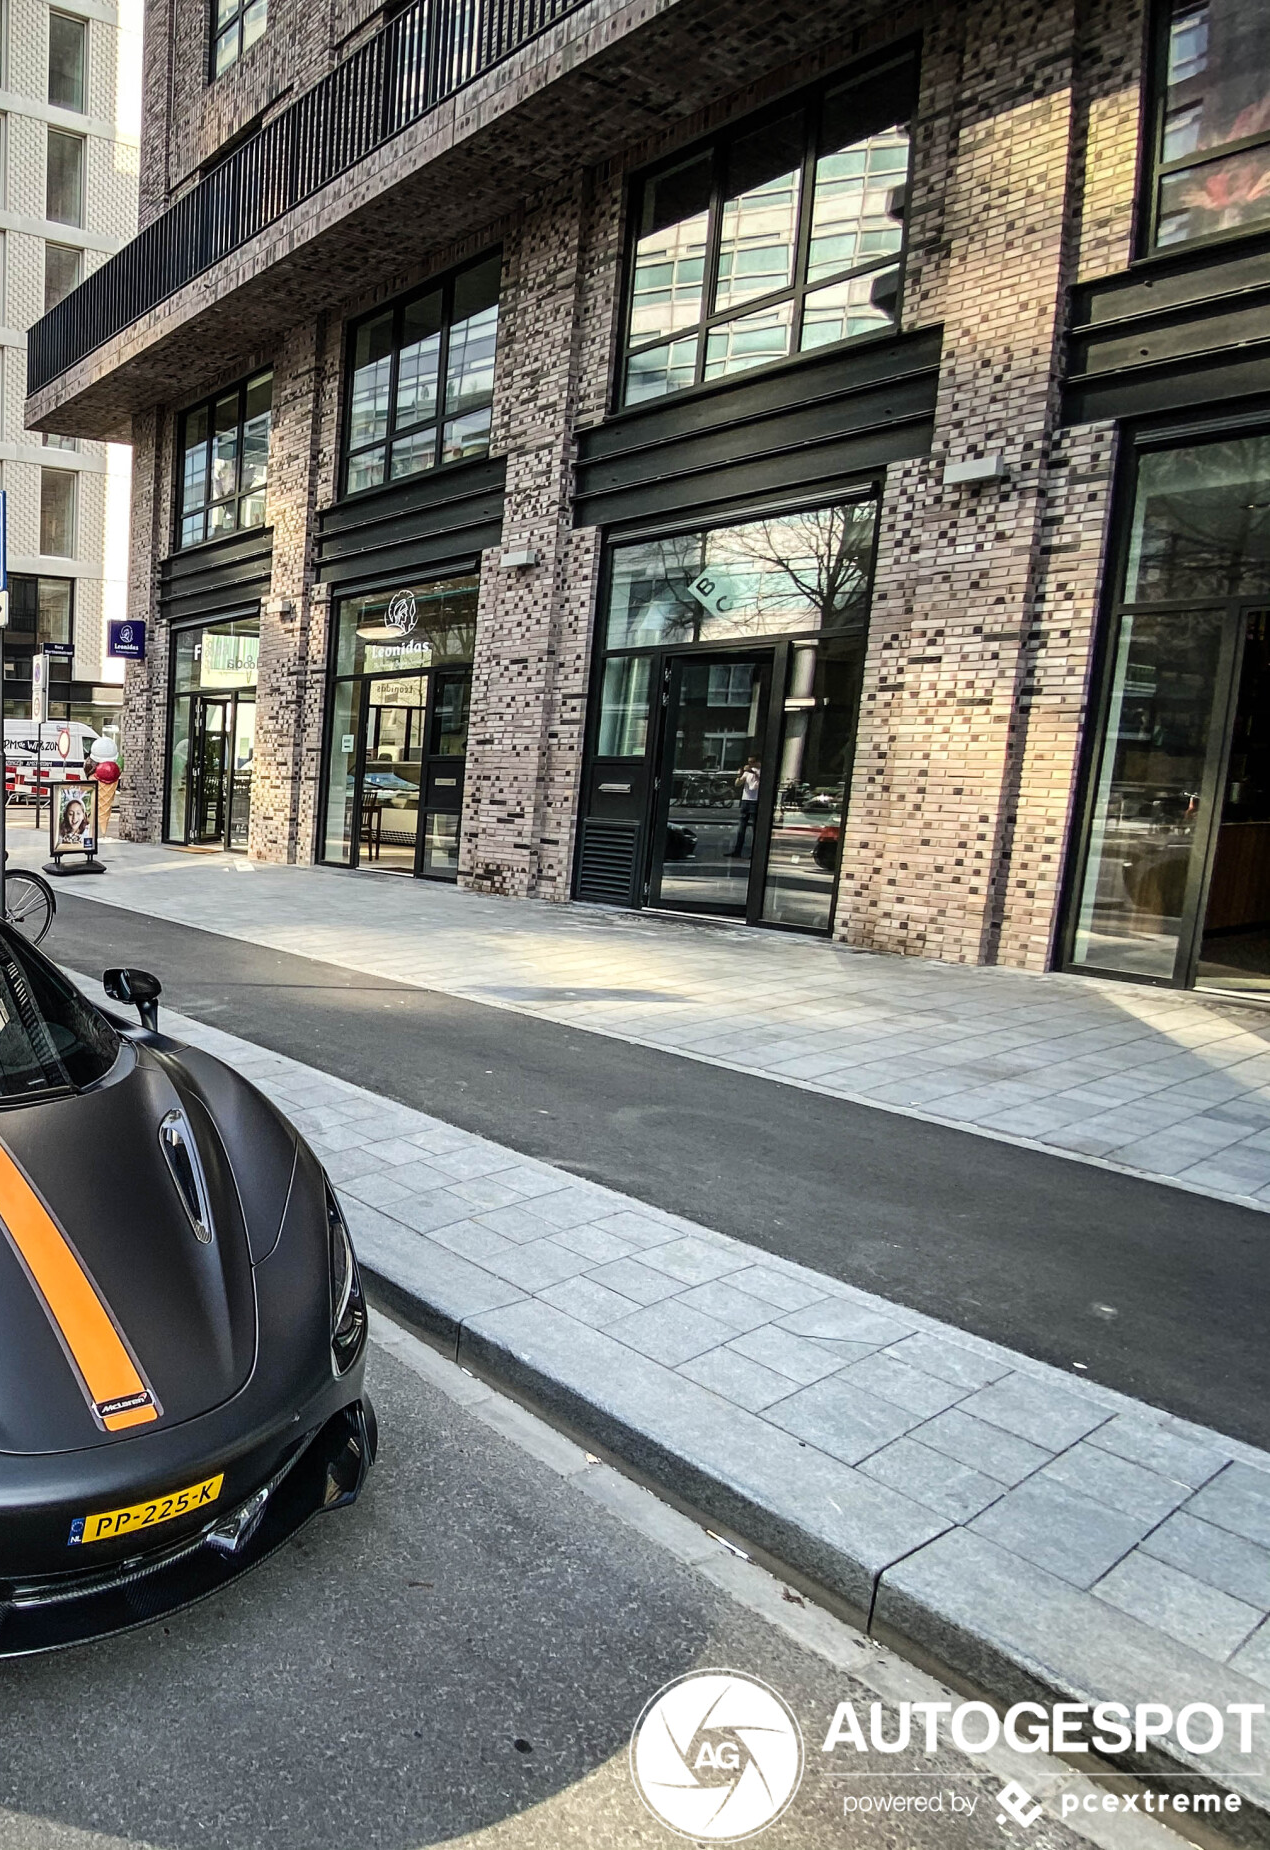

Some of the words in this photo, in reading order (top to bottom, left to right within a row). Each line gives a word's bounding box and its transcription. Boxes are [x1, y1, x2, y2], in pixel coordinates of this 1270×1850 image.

[114, 643, 139, 651] Leonidas
[372, 639, 430, 659] Leonidas
[101, 1397, 145, 1413] McLaren
[95, 1481, 214, 1537] PP-225-K
[69, 1534, 82, 1544] NL
